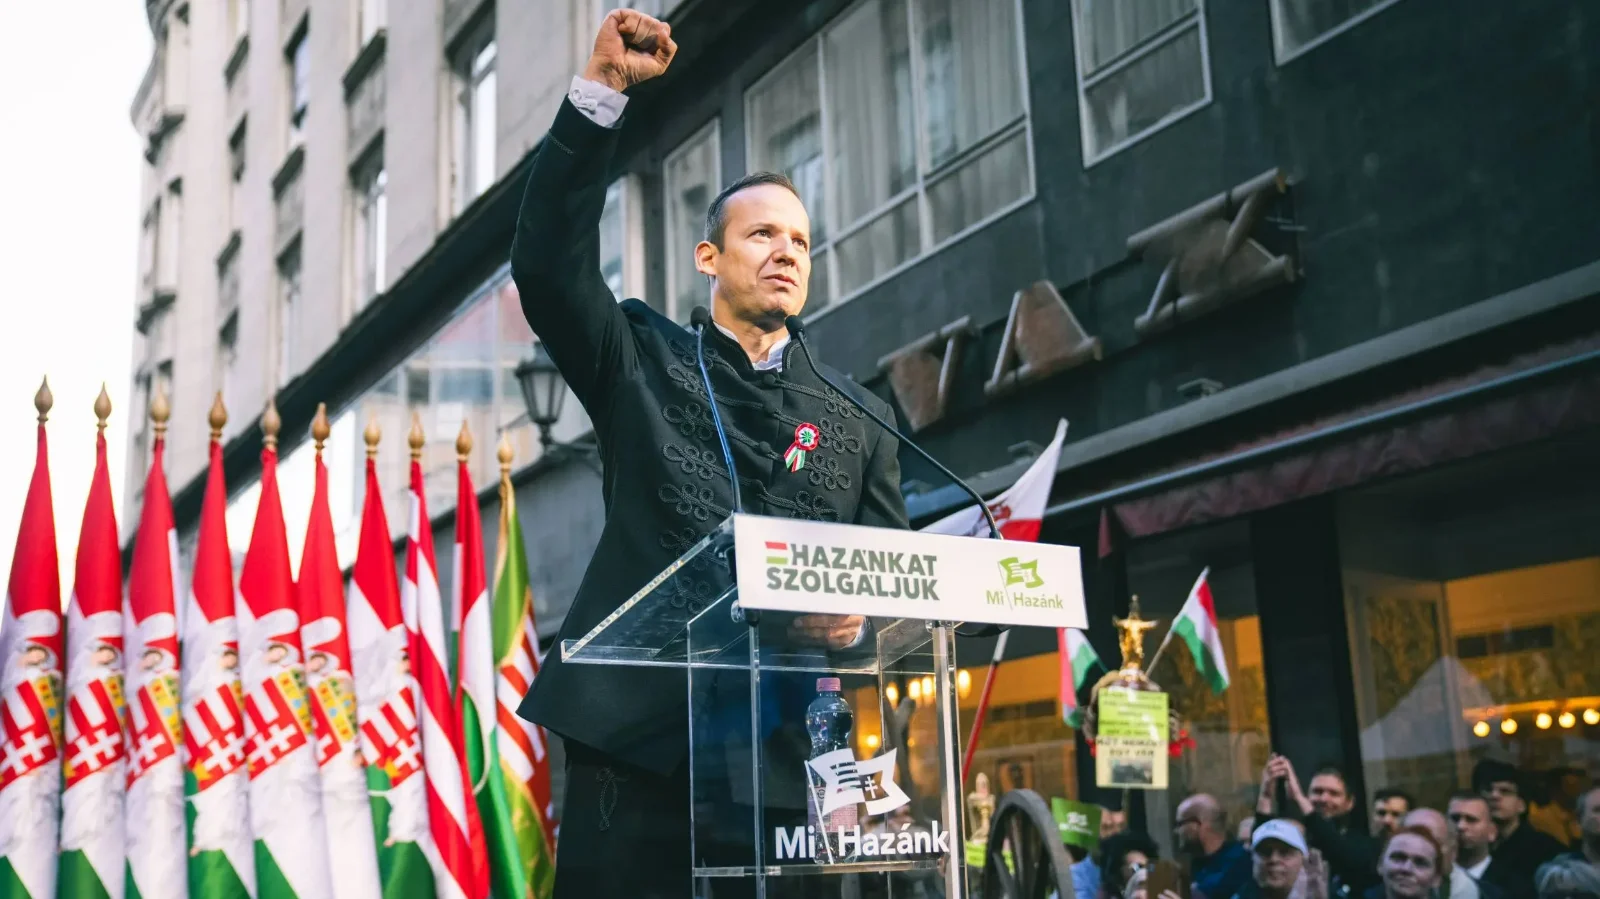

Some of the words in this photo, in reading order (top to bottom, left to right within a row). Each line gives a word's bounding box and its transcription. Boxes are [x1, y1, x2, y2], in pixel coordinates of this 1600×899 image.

[790, 543, 937, 577] HAZÁNKAT
[766, 566, 940, 601] SZOLGÁLJUK
[986, 590, 1004, 606] Mi
[1013, 592, 1064, 609] Hazánk
[775, 825, 815, 860] Mi
[838, 820, 950, 857] Hazánk
